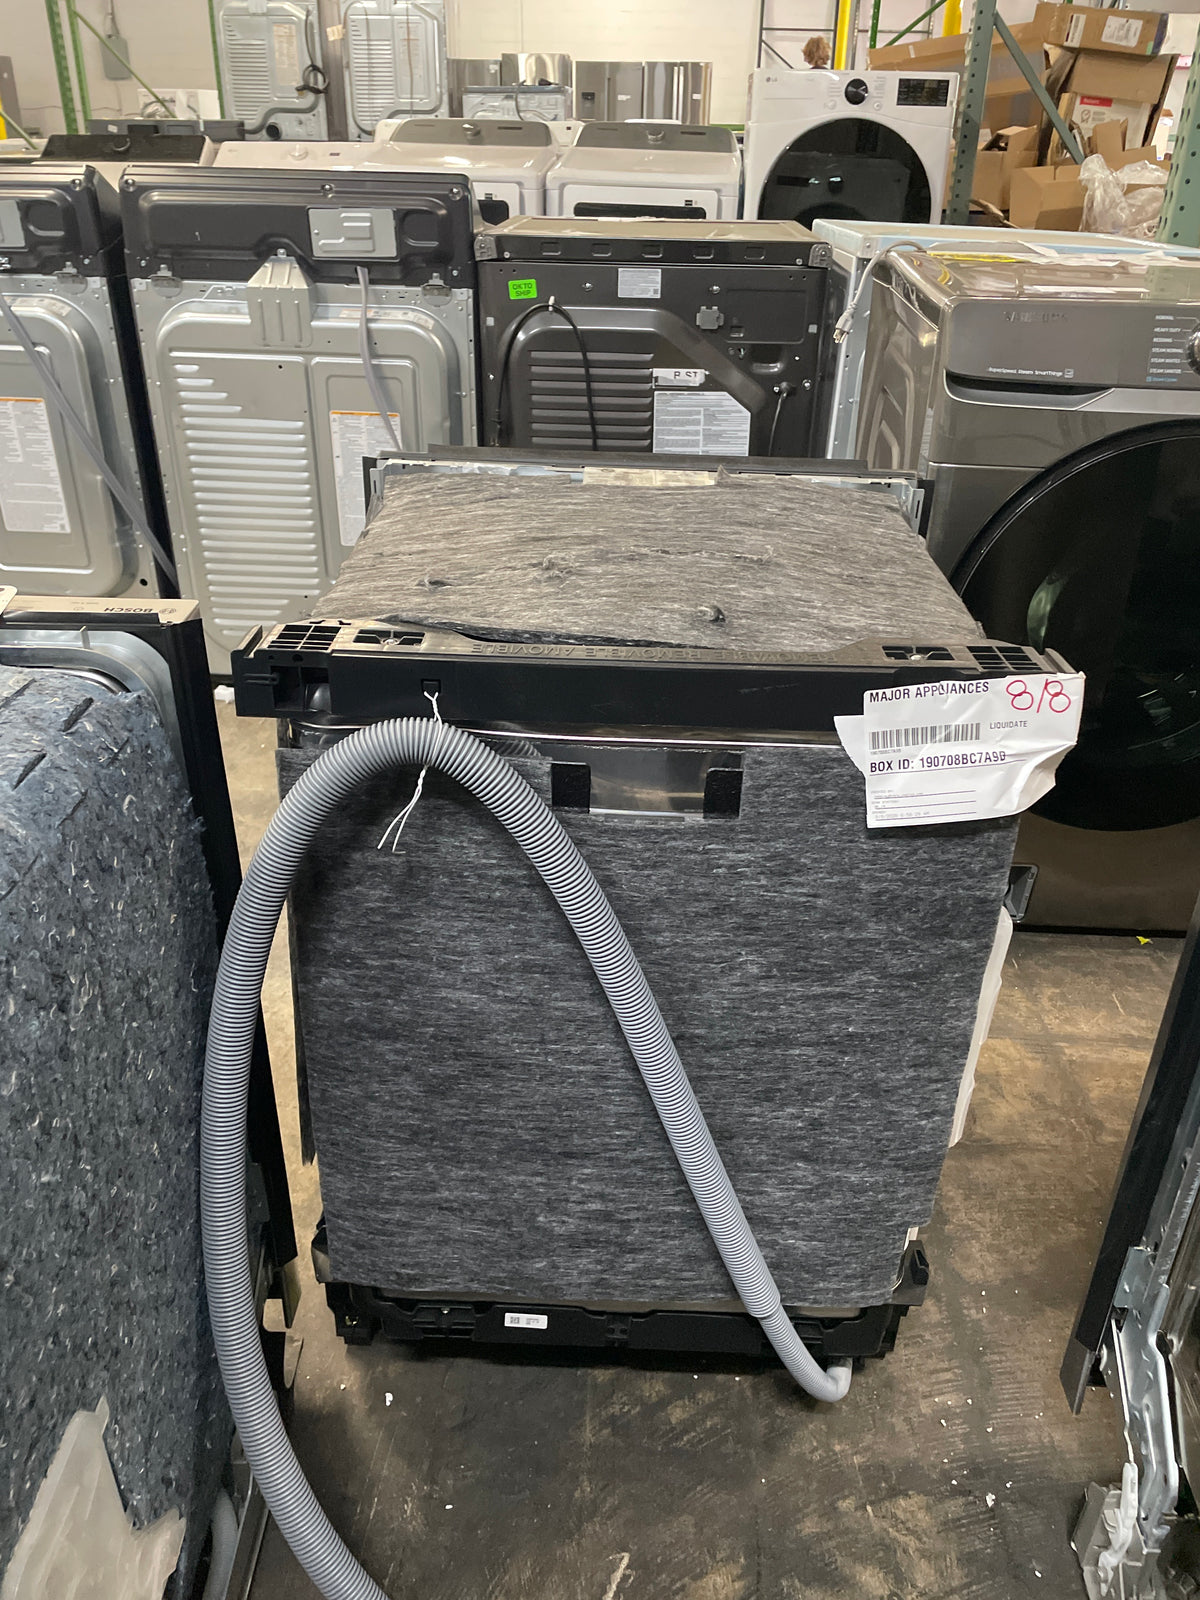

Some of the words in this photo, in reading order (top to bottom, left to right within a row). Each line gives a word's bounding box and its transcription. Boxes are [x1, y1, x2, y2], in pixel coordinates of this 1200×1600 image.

[869, 688, 911, 703] MAJOR
[915, 681, 990, 698] APPLIANCES
[1006, 678, 1071, 713] 8/8
[989, 721, 1028, 730] LIQUIDATE
[870, 760, 893, 773] BOX
[898, 758, 915, 770] ID:
